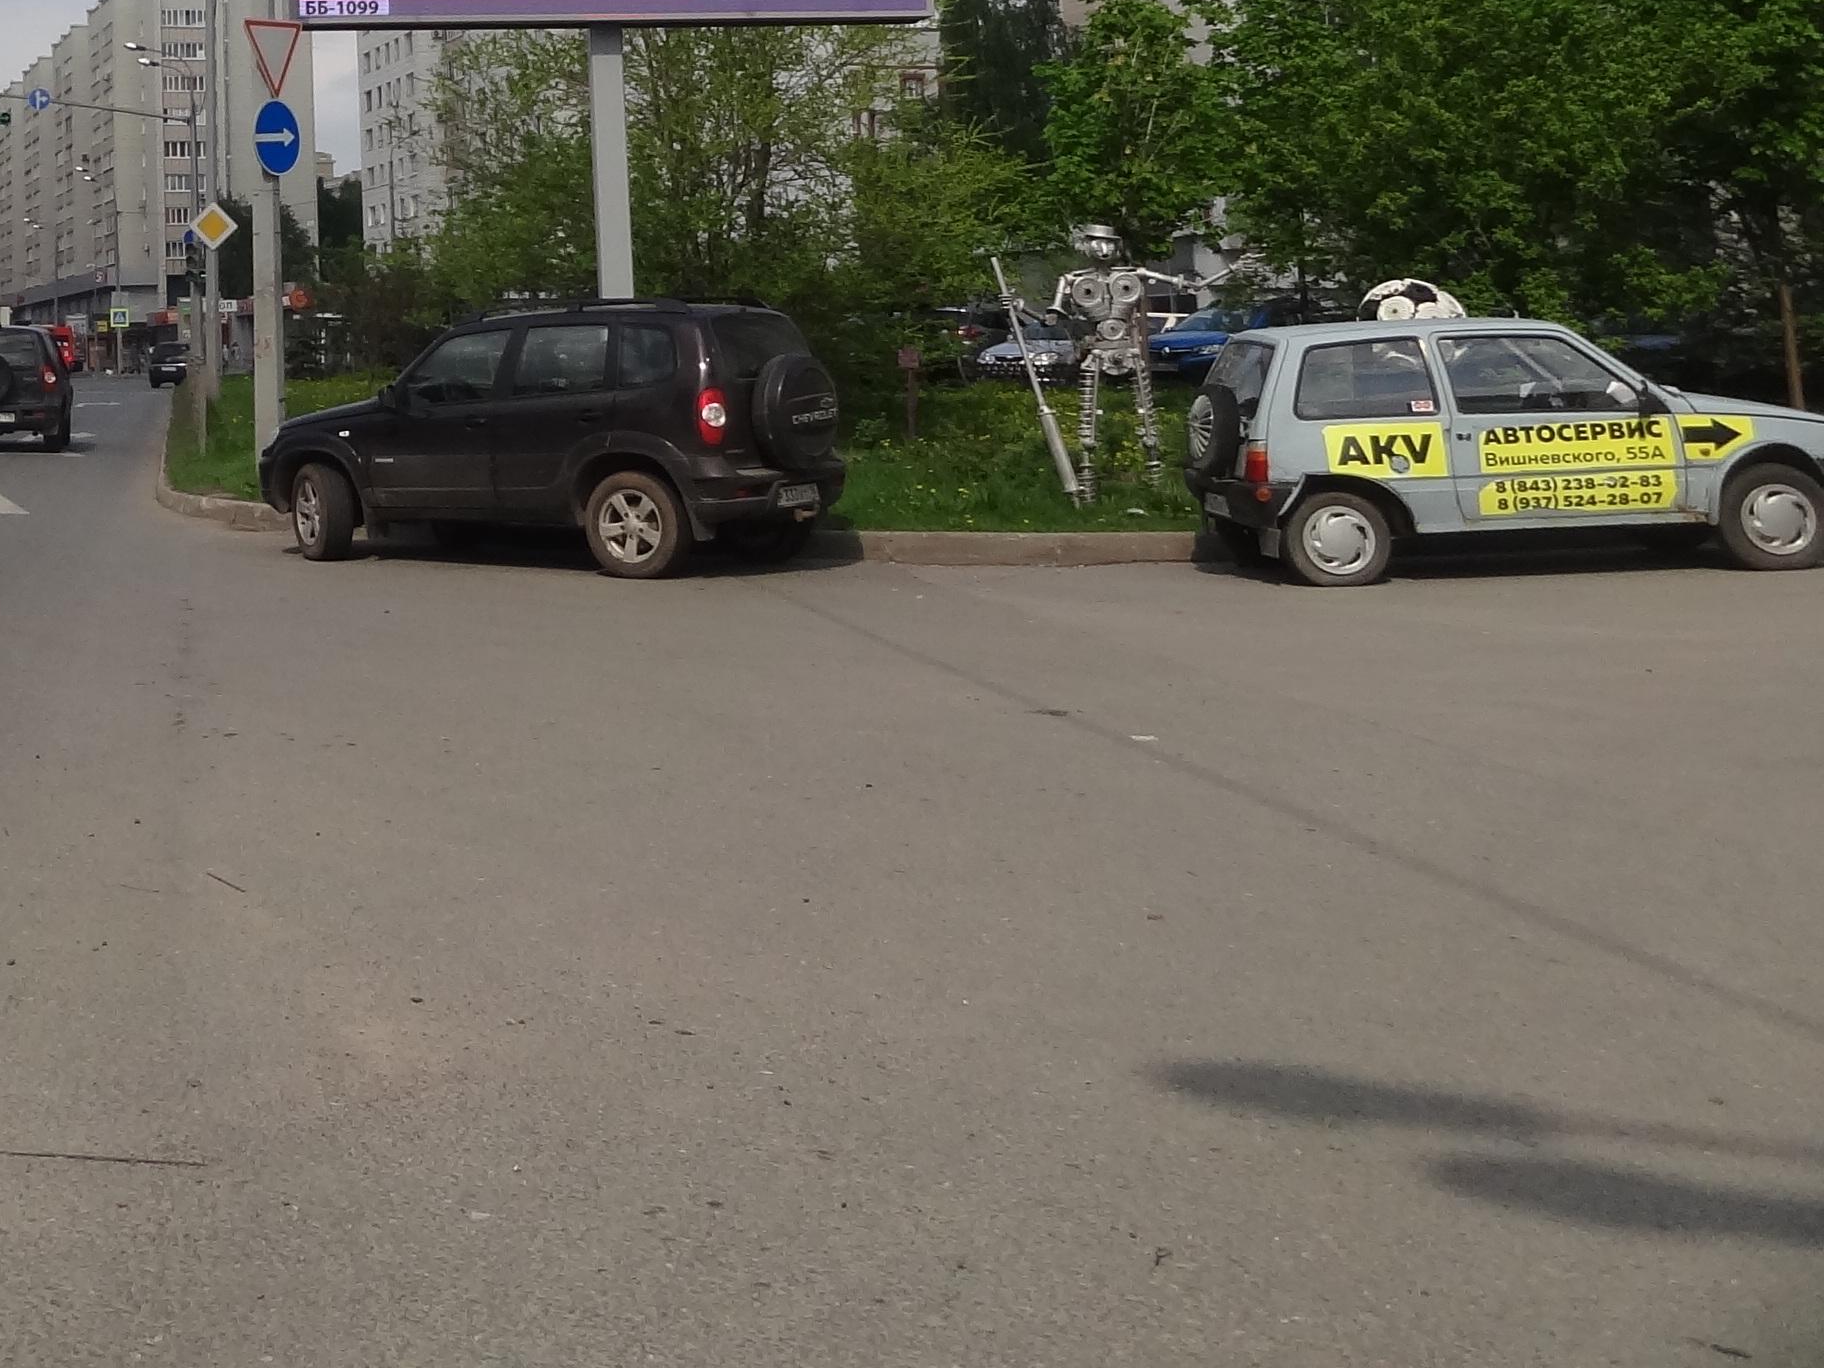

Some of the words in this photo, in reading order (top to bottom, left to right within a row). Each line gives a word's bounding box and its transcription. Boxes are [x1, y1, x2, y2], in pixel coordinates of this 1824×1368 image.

[305, 0, 379, 15] ББ-1099
[1483, 420, 1663, 445] АВТОСЕРВИС
[1338, 434, 1432, 465] AKV
[1485, 449, 1622, 467] Вишневского,
[1626, 446, 1666, 460] 55А
[1495, 481, 1506, 494] 8
[1511, 477, 1557, 494] (843)
[1498, 498, 1509, 510] 8
[1513, 494, 1559, 511] (937)
[1563, 492, 1663, 508] 524-28-07
